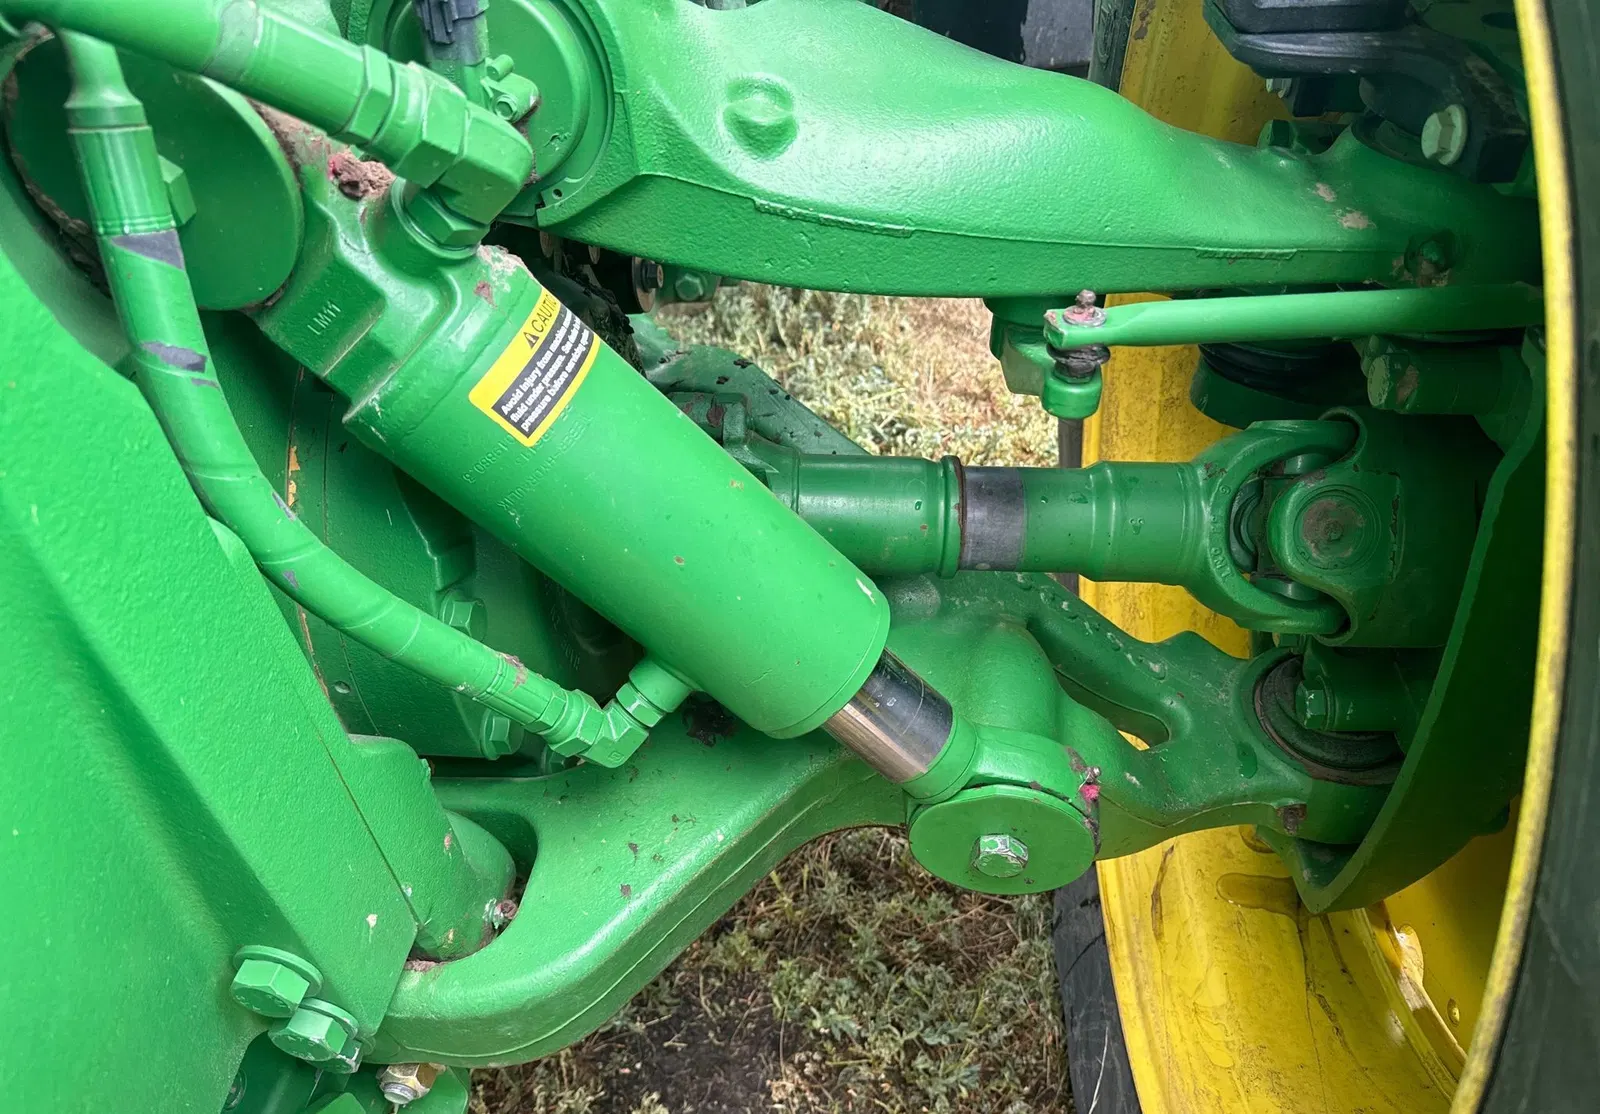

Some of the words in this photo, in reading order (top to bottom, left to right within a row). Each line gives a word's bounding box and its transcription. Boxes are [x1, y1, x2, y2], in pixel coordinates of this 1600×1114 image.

[531, 294, 557, 332] CAUTIO
[501, 388, 523, 415] Avoid
[536, 349, 553, 369] from
[548, 325, 567, 351] machine
[509, 402, 528, 422] fluid
[524, 382, 544, 405] under
[561, 341, 572, 353] See
[520, 393, 552, 431] pressure
[546, 369, 568, 396] before
[564, 342, 585, 373] servicing
